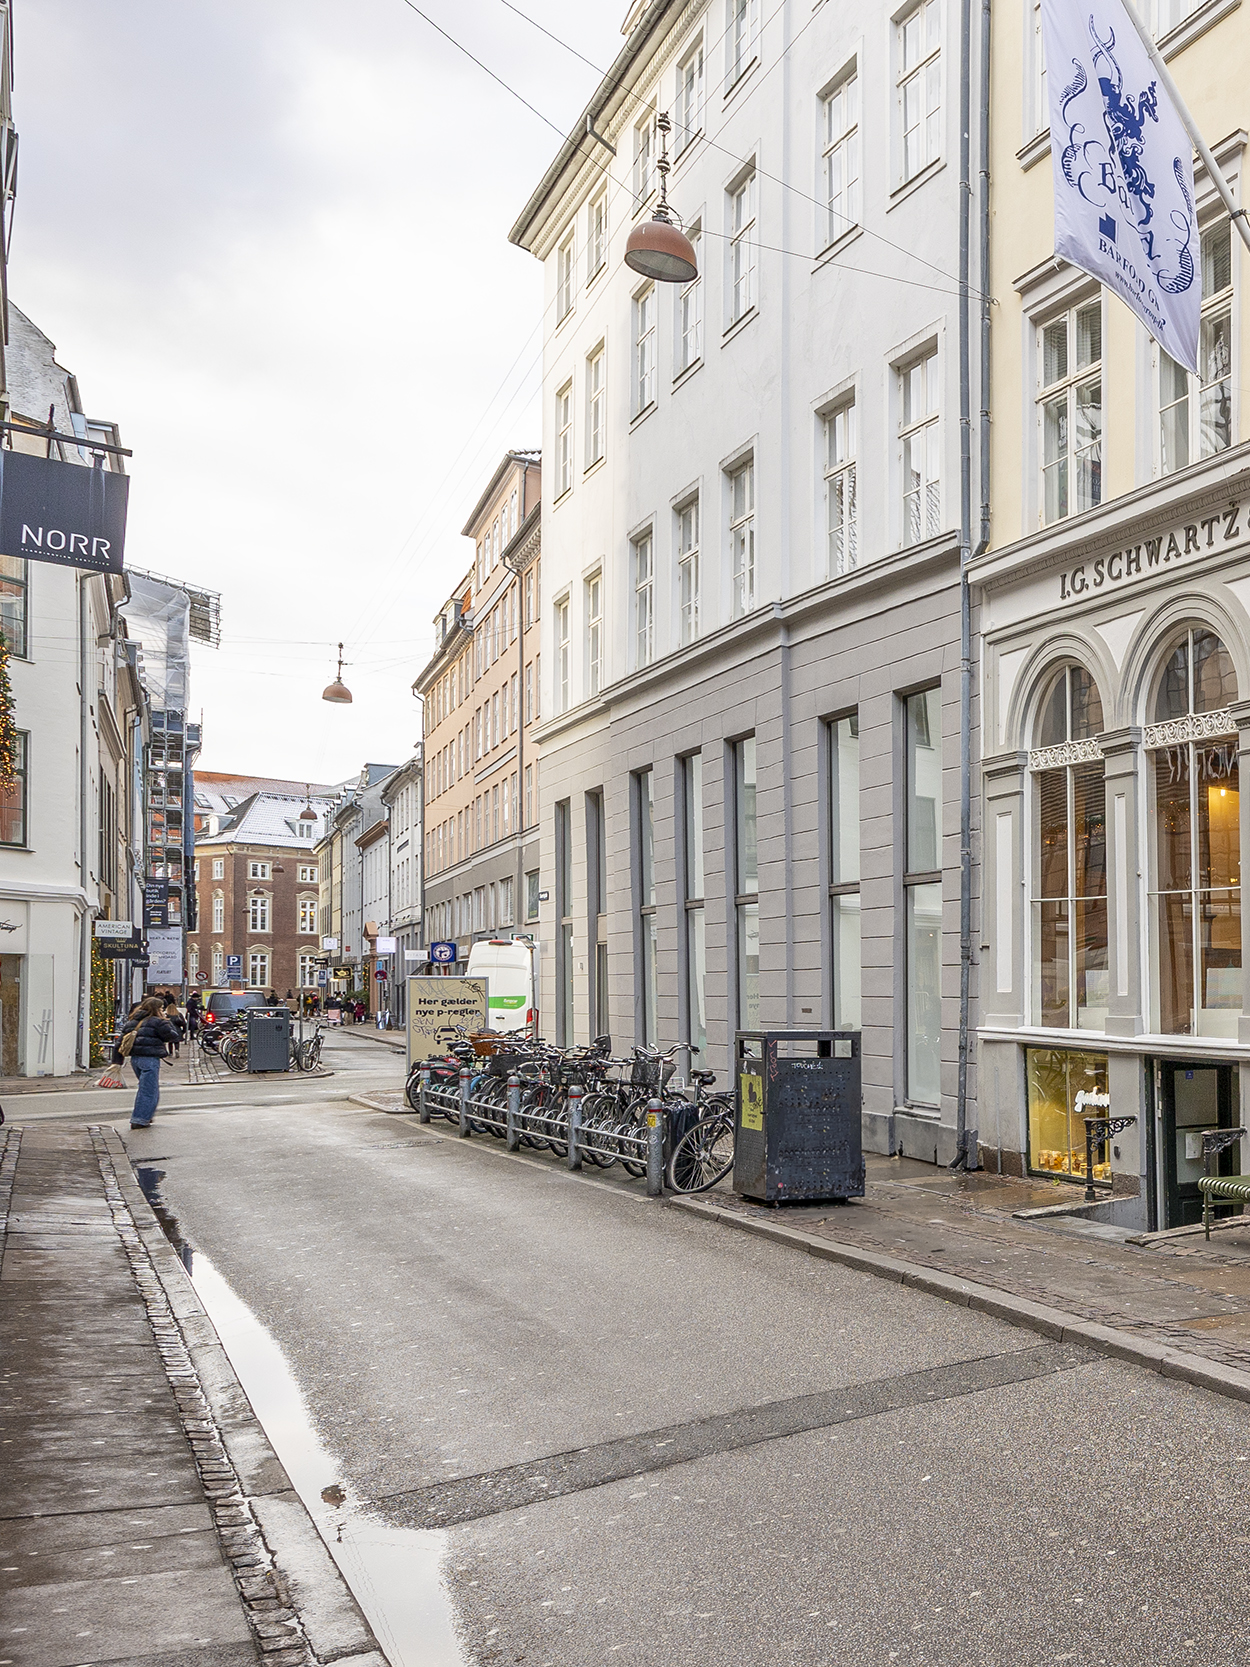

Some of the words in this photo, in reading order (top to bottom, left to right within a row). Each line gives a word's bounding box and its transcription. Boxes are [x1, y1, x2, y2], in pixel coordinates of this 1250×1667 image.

[1099, 238, 1146, 293] BARFOD
[21, 523, 112, 560] NORR
[1093, 507, 1240, 588] SCHWARTZ
[415, 1009, 435, 1017] nye
[437, 1008, 481, 1017] p-regler
[441, 998, 478, 1007] gælder
